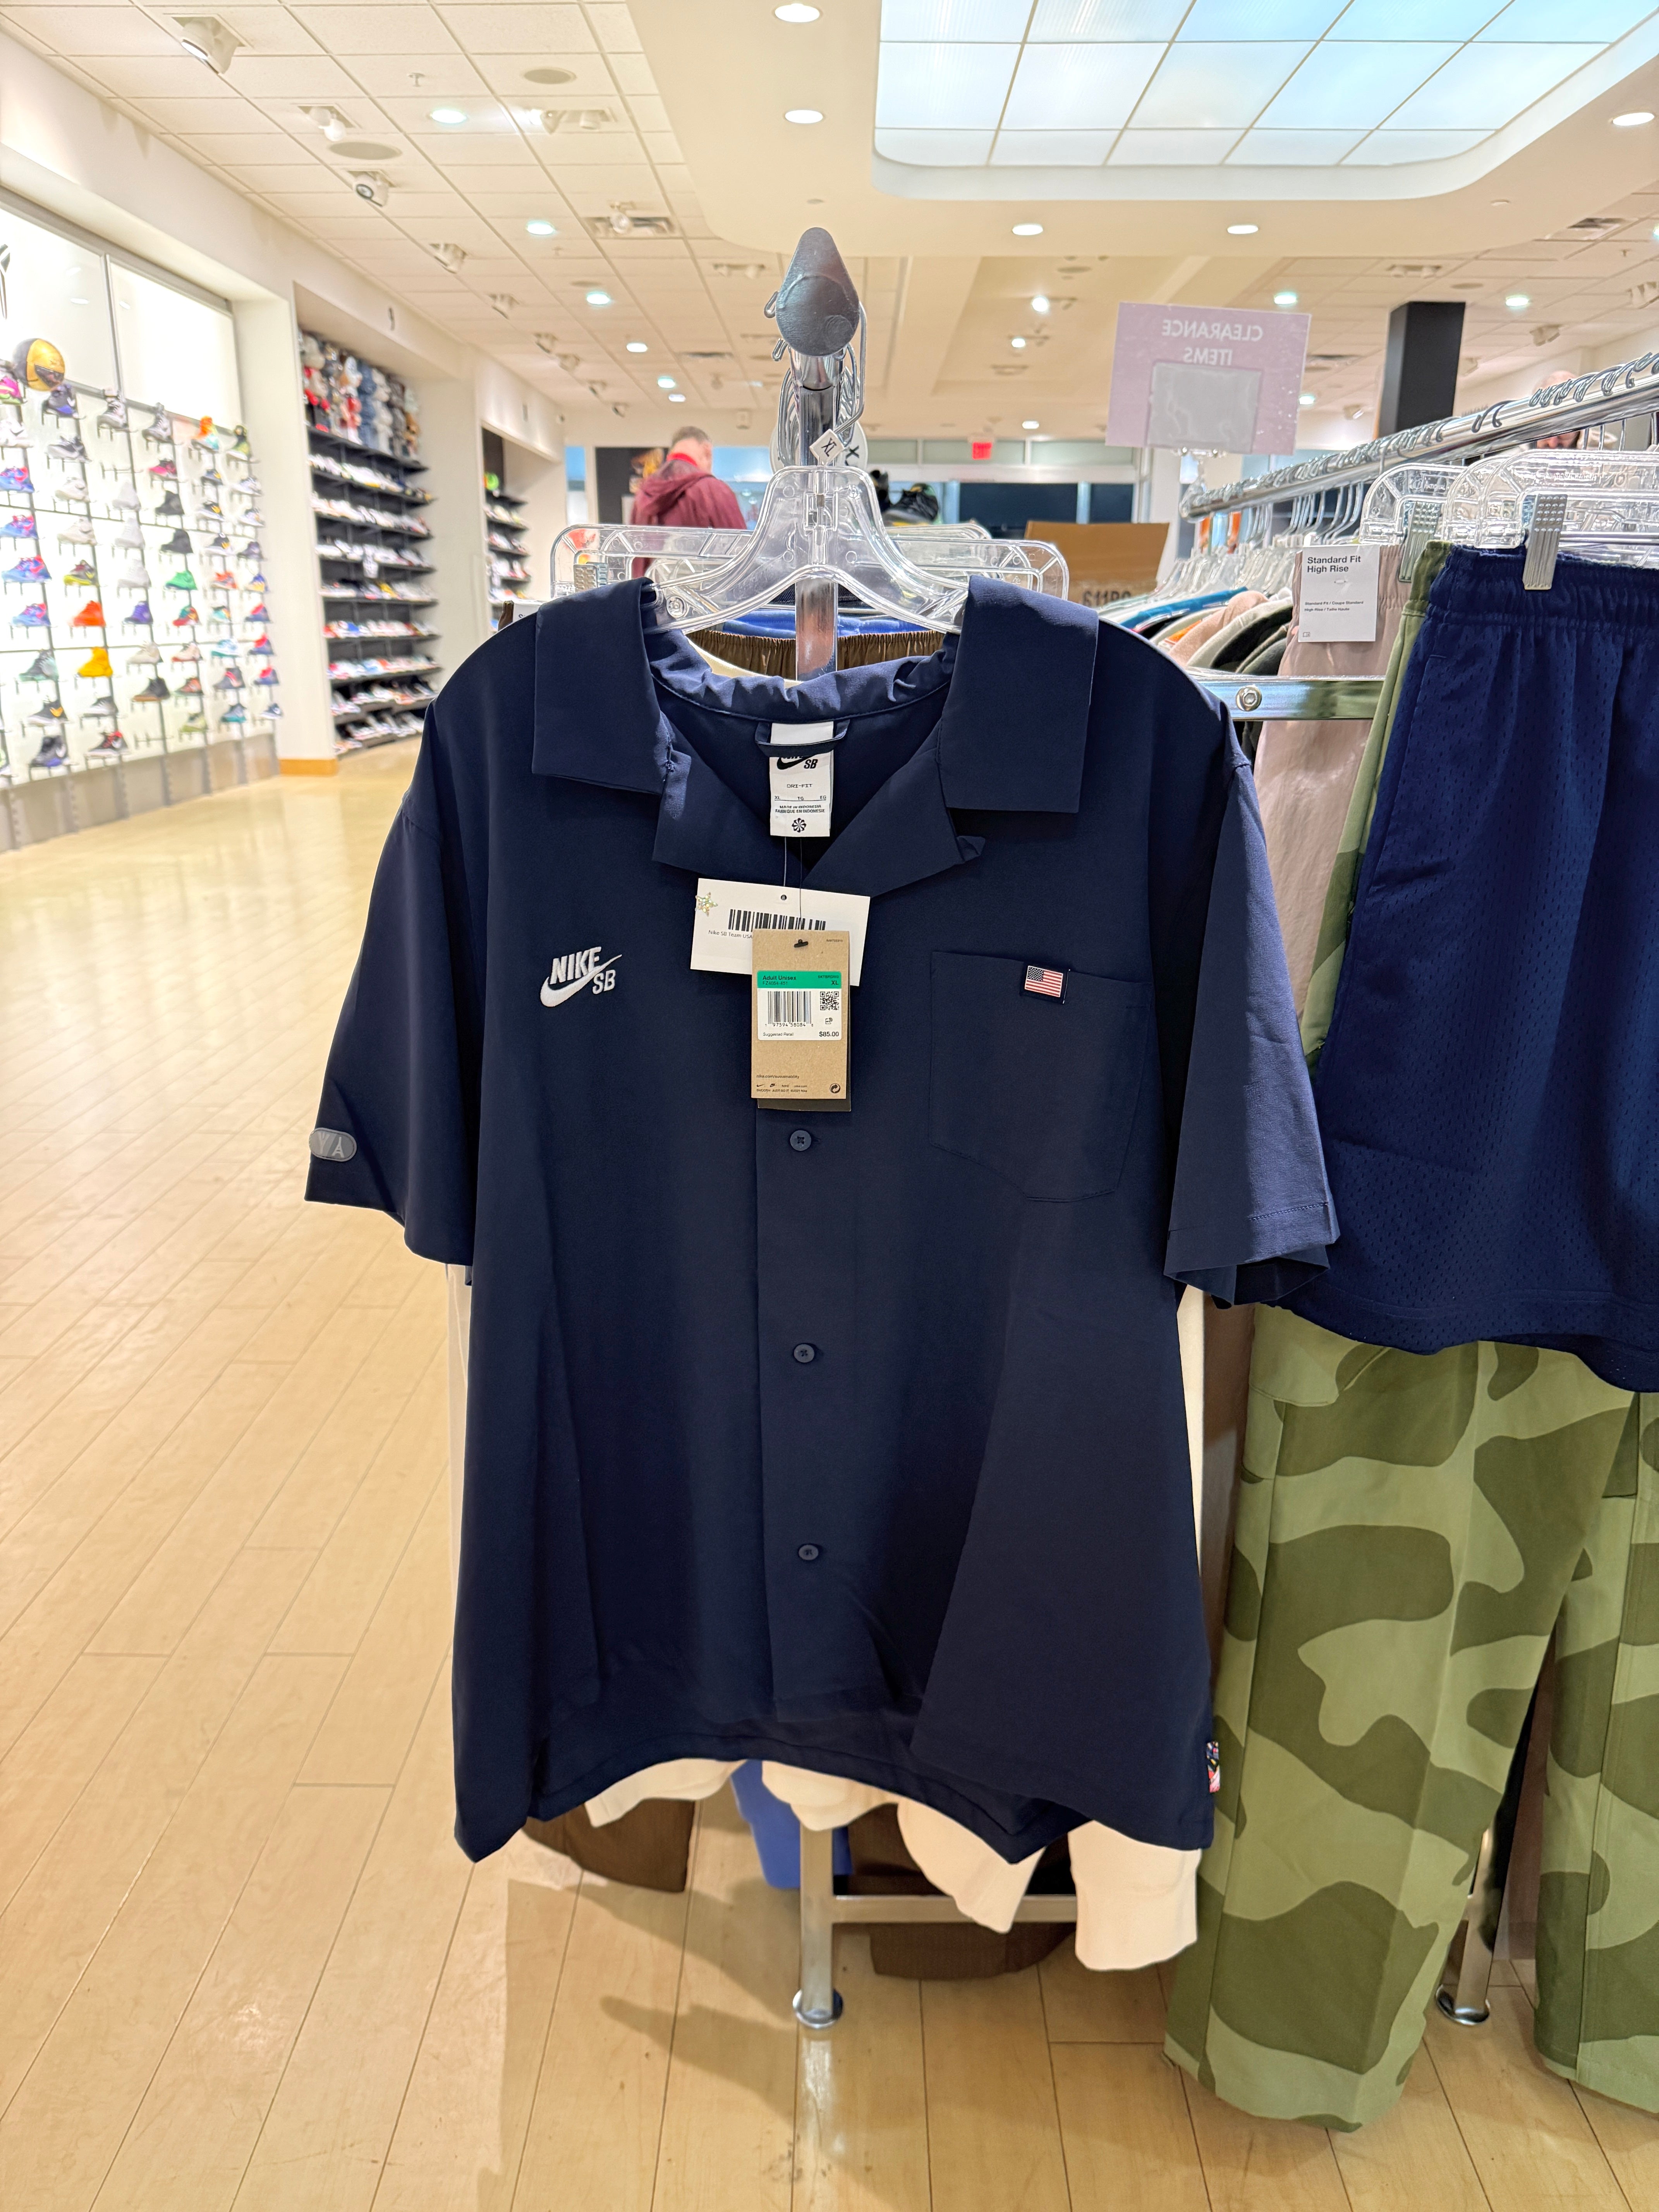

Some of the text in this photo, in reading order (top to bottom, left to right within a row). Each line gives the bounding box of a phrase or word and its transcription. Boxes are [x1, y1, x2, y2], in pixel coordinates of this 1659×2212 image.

[821, 437, 837, 457] XL
[1307, 566, 1327, 574] High
[804, 759, 818, 769] SB
[550, 946, 601, 984] NIKE
[592, 970, 616, 994] SB
